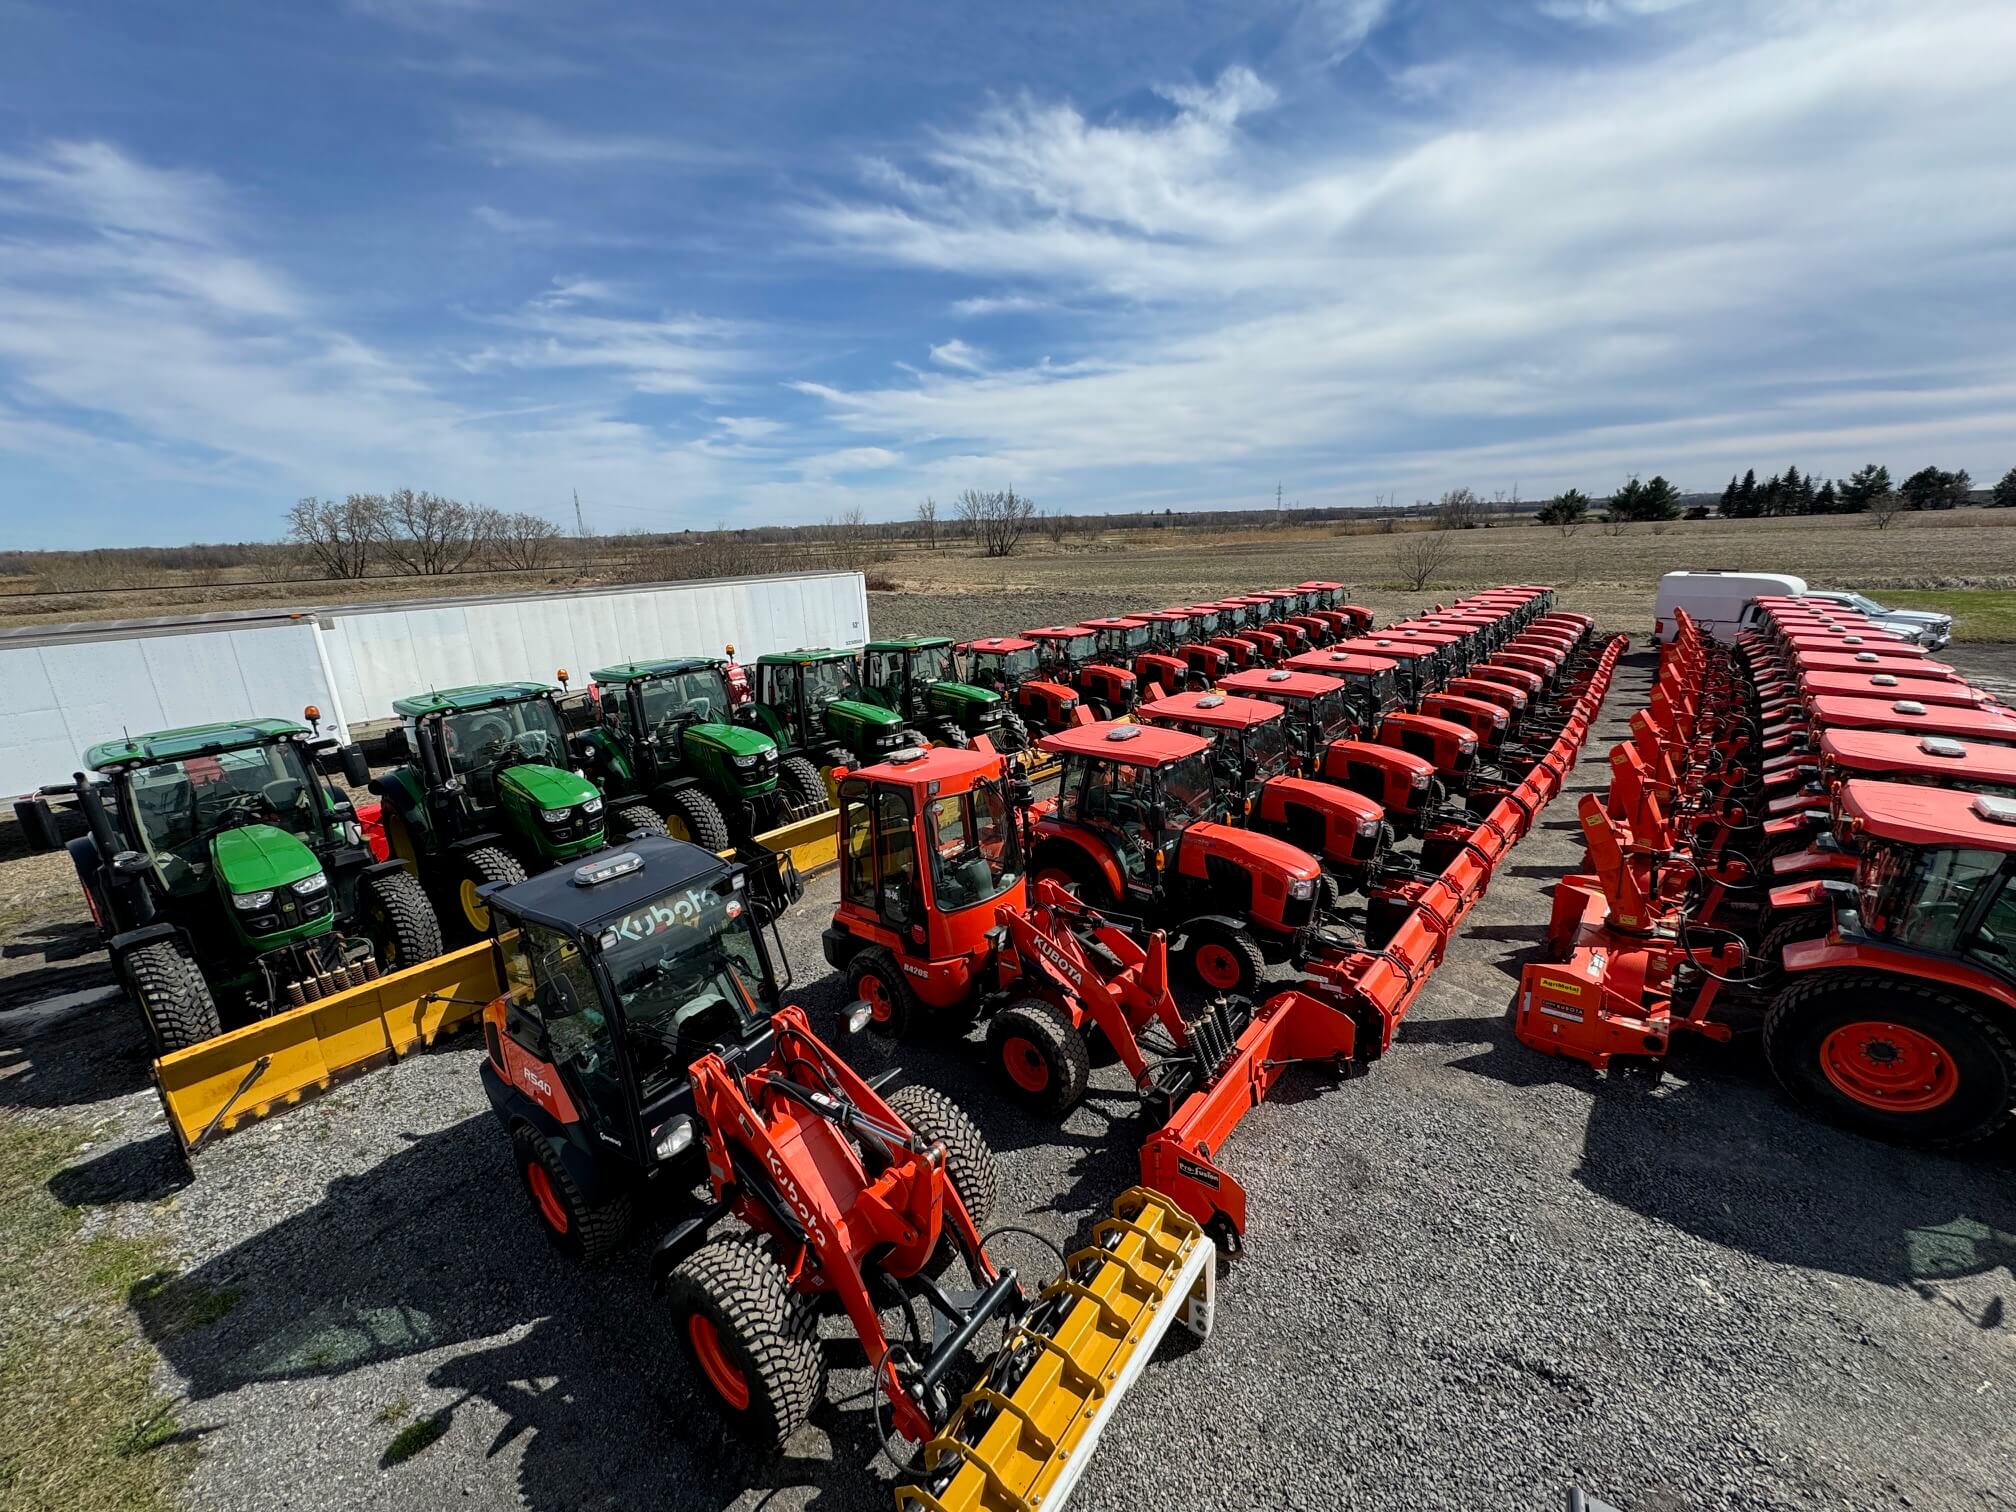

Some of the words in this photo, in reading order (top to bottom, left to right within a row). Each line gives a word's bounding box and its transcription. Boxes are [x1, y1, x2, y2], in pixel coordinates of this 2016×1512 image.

[607, 889, 720, 941] Kubota
[903, 963, 929, 979] R420S
[1033, 935, 1082, 985] KUBOTA
[523, 1067, 552, 1097] R540
[766, 1148, 826, 1247] Kubota
